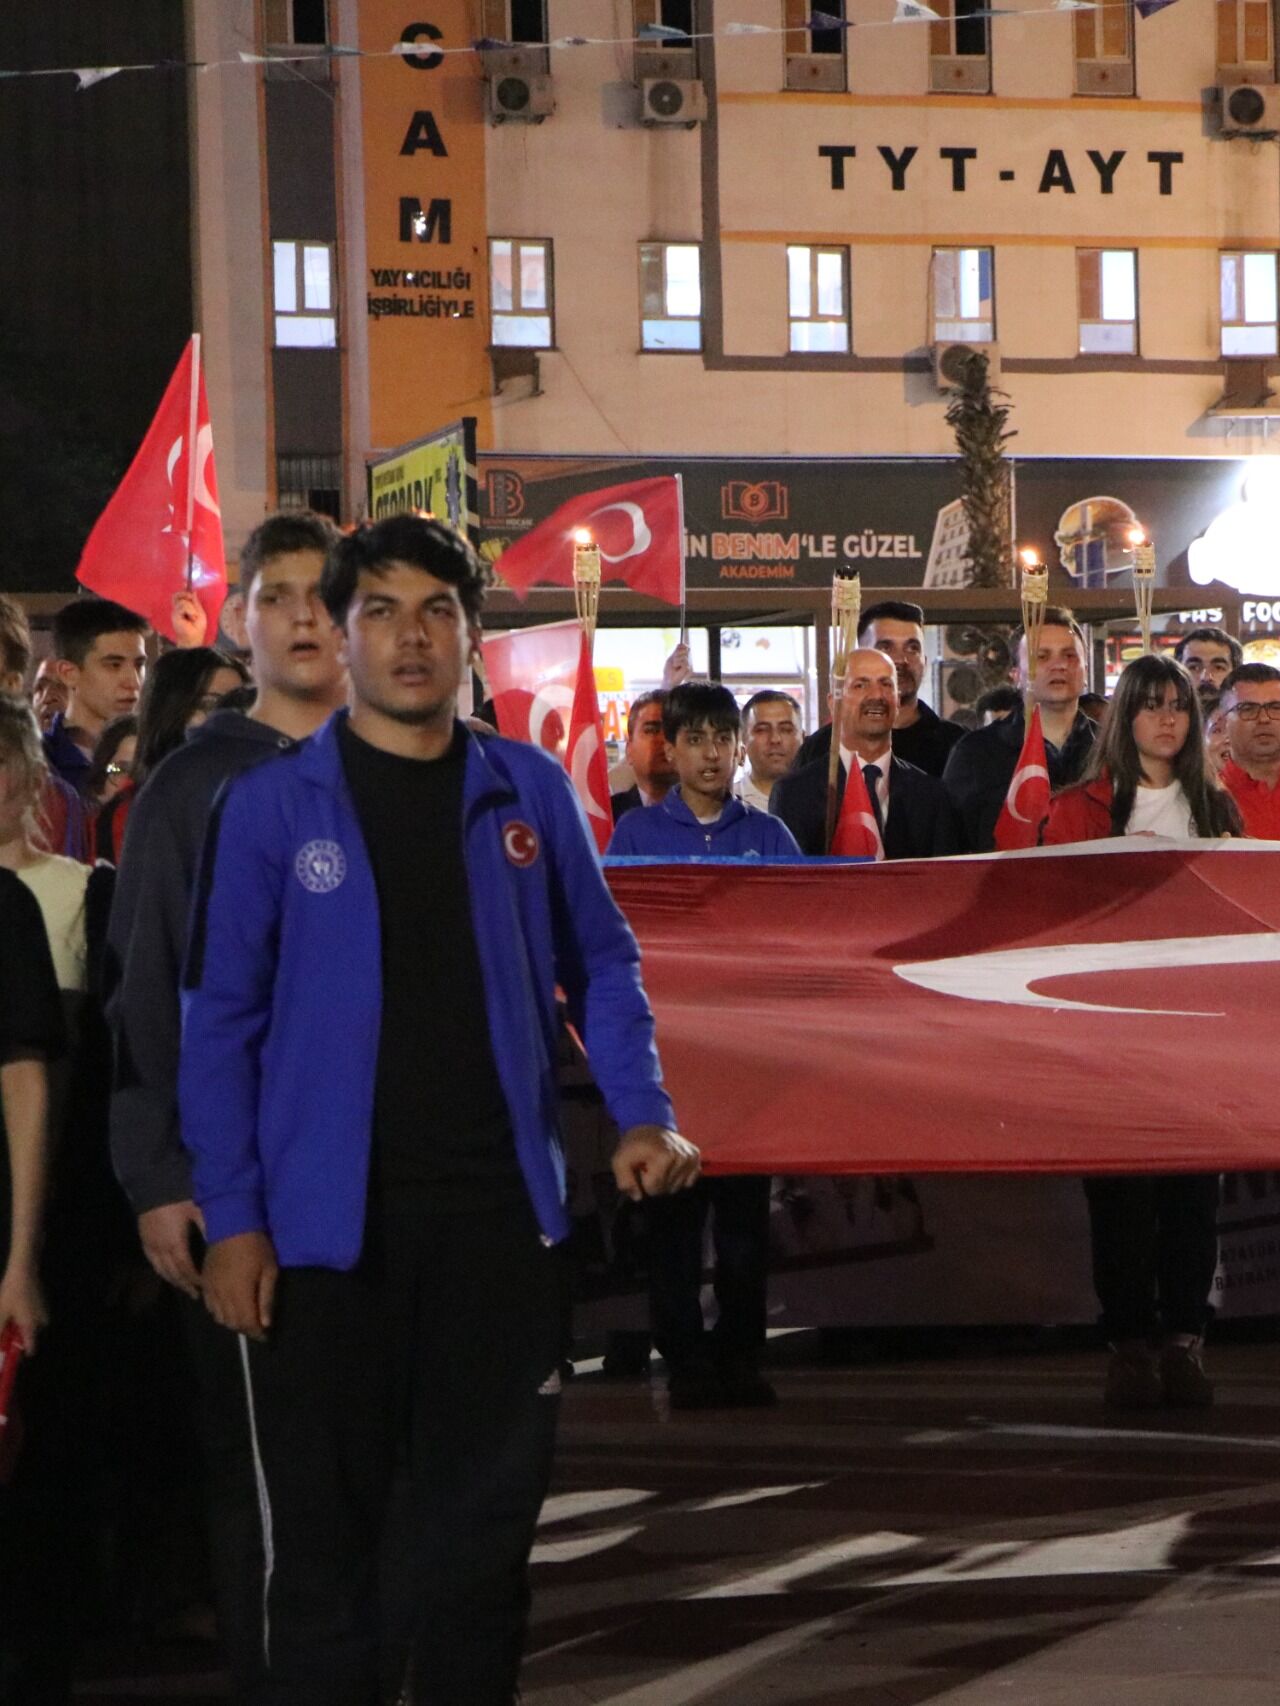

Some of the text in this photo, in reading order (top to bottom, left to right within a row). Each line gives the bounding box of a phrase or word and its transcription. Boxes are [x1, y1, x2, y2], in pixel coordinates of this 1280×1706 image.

[683, 529, 707, 558] İN
[842, 530, 922, 558] GÜZEL
[719, 563, 795, 579] AKADEMİM
[1178, 608, 1224, 624] FAS
